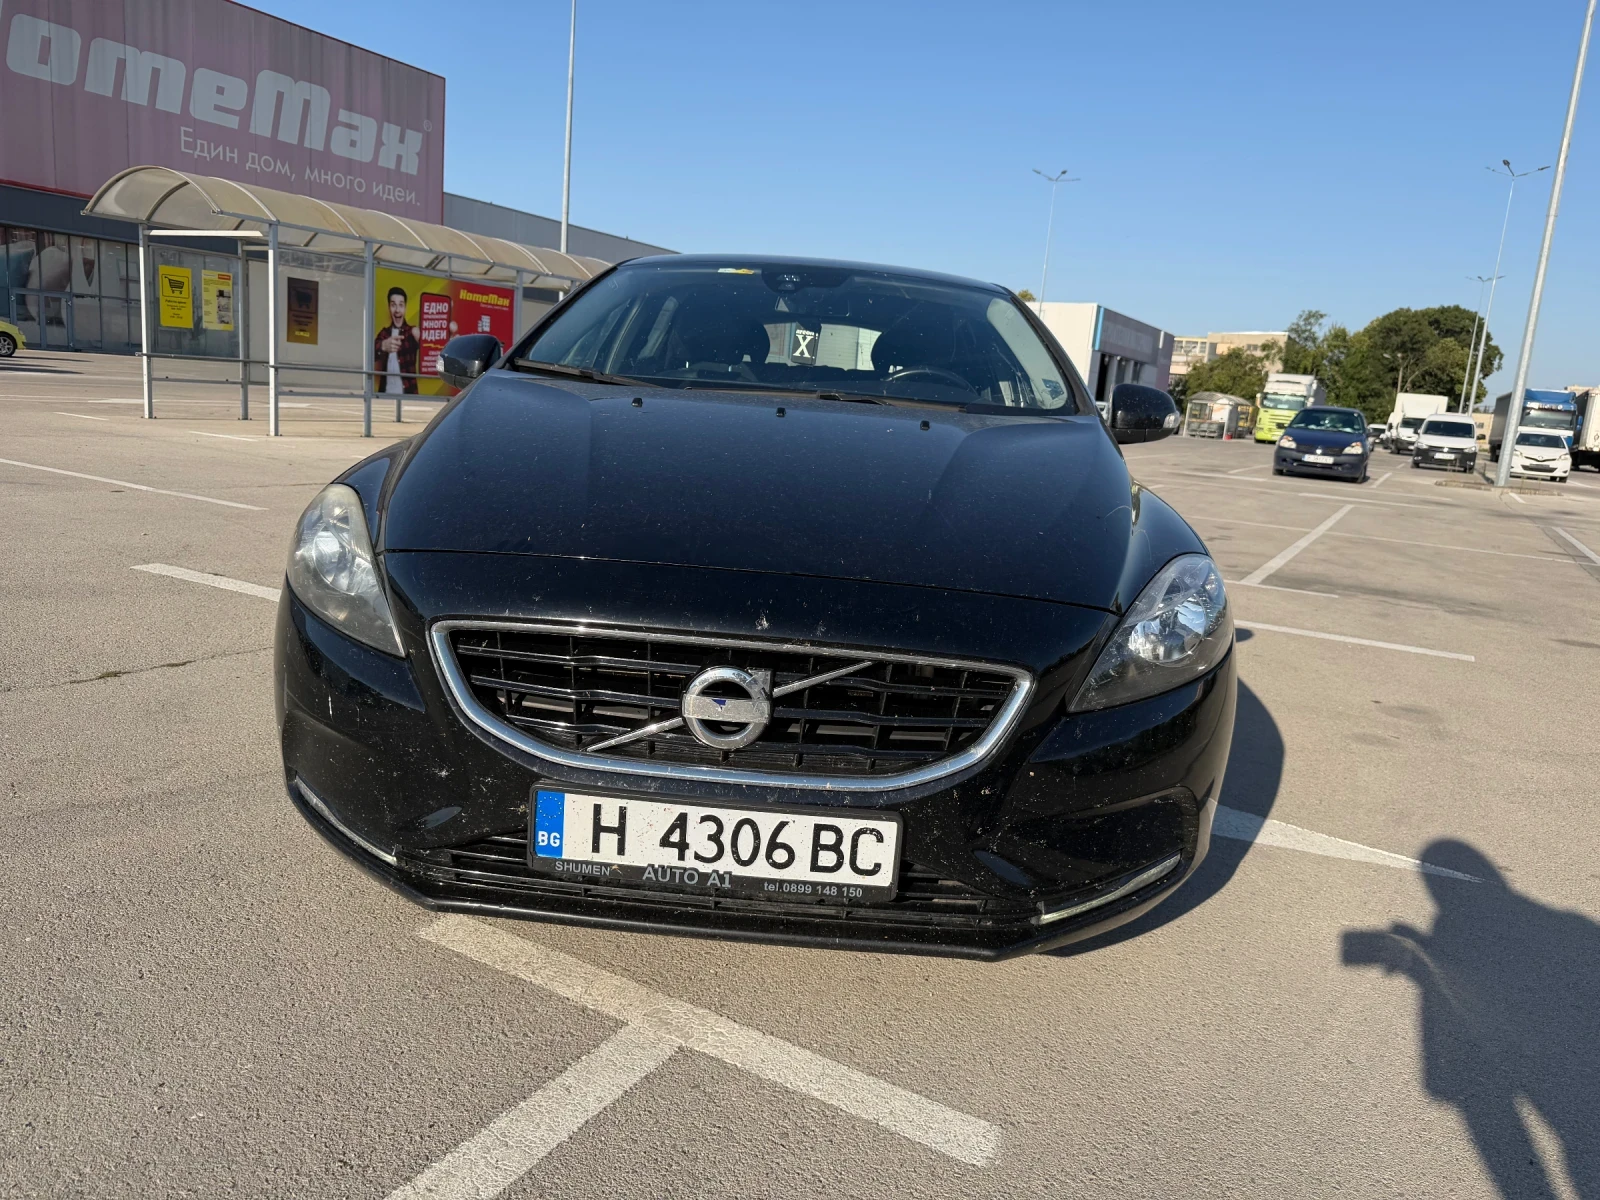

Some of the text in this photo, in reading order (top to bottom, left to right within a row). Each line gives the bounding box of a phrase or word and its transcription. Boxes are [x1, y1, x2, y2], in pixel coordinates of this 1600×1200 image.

[0, 0, 423, 176] omeMax
[180, 126, 421, 206] Един дом, много идеи.
[460, 289, 510, 306] HomeMax
[424, 303, 449, 314] ЕДНО
[423, 320, 447, 329] МНОГО
[422, 330, 446, 341] ИДЕИ
[792, 334, 814, 358] X
[537, 831, 561, 847] BG
[591, 803, 885, 877] H 4306 BC
[554, 861, 611, 877] SHUMEN
[642, 865, 732, 888] AUTO A1
[763, 880, 864, 899] tel.0899 148 150
